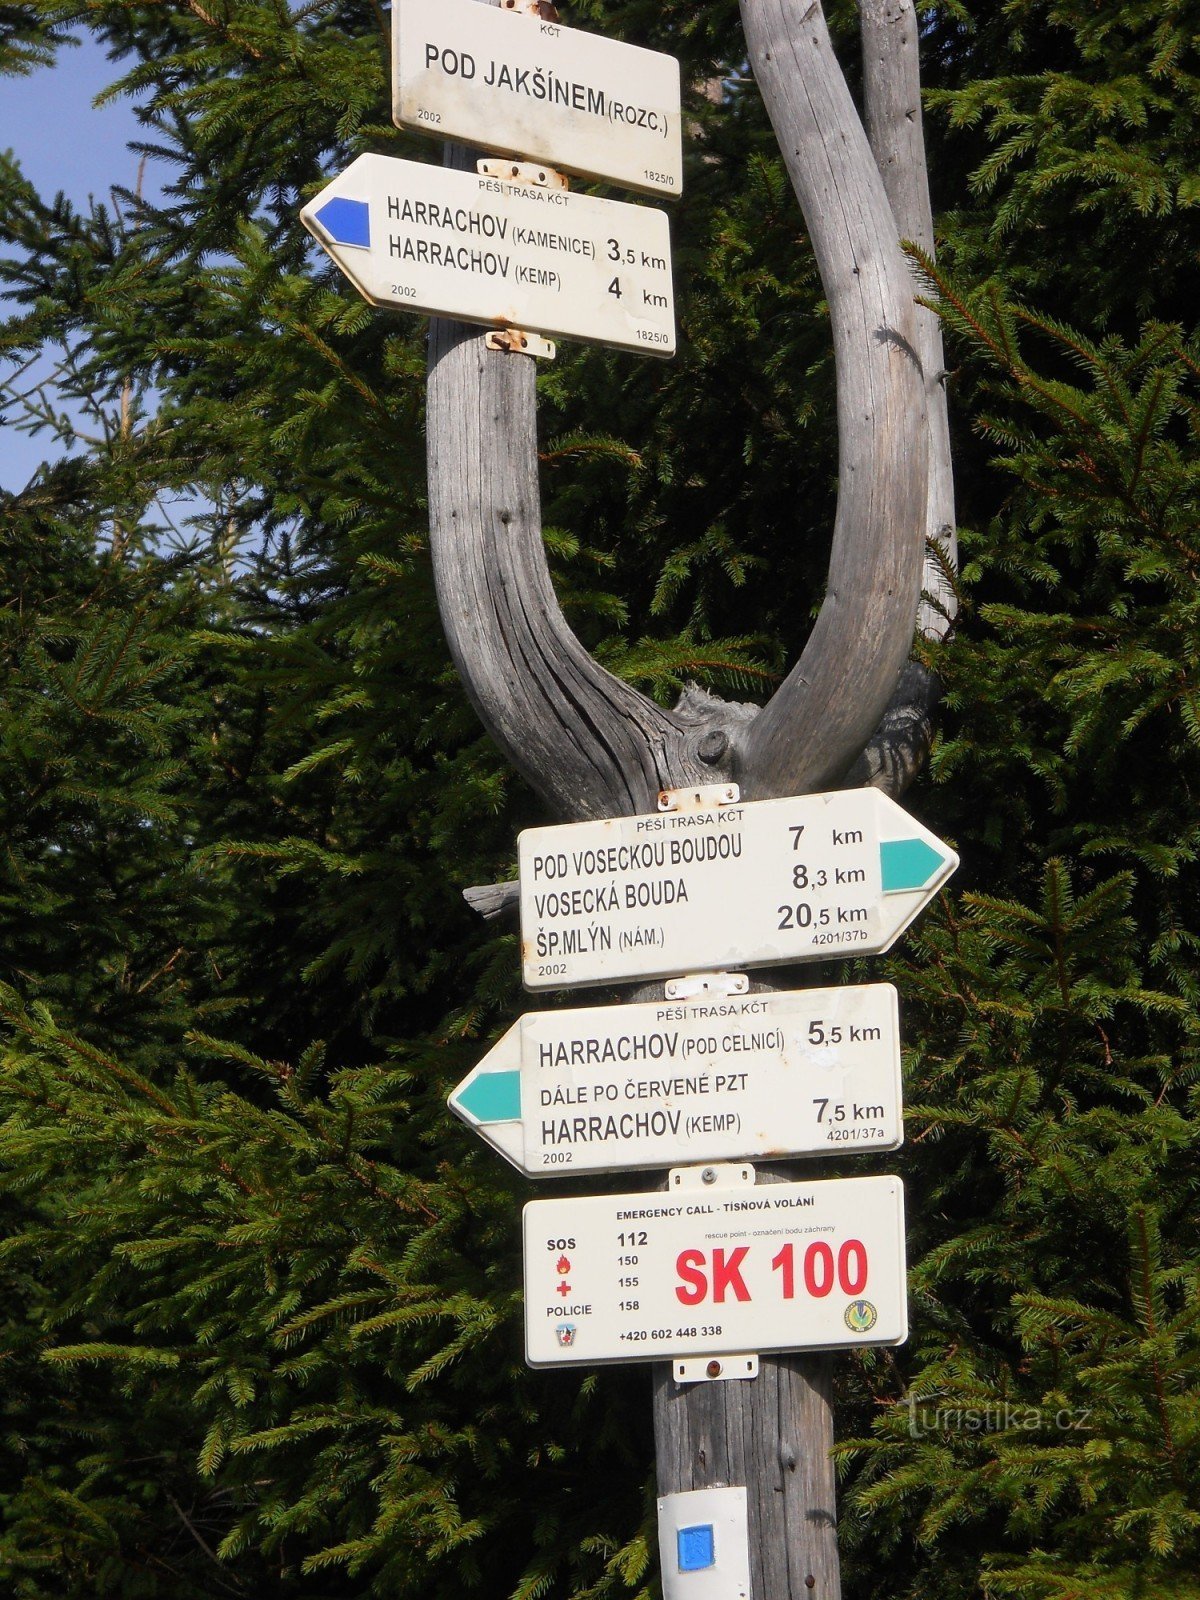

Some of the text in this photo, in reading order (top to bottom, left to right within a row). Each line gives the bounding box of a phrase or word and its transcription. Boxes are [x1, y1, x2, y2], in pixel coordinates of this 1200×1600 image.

[540, 24, 560, 38] KČT
[426, 44, 475, 79] POD
[418, 109, 441, 124] 2002
[644, 169, 674, 186] 1825/0
[478, 180, 569, 206] PĚŠÍ TRASA KČT
[388, 196, 666, 270] HARRACHOV (KAMENICE) 3,5 km
[389, 234, 668, 308] HARRACHOV (KEMP) 4 km
[391, 285, 417, 298] 2002
[636, 330, 668, 344] 1825/0
[637, 809, 744, 832] PĚŠÍ TRASA KČT
[534, 826, 863, 880] POD VOSECKOU BOUDOU 7 km
[535, 865, 865, 918] VOSECKÁ BOUDA 8,3 km
[537, 903, 868, 957] ŠP.MLÝN (NÁM.) 20,5 km
[812, 930, 868, 945] 4201/37b
[538, 963, 567, 976] 2002
[656, 1001, 768, 1021] PĚŠÍ TRASA KČT
[540, 1021, 881, 1067] HARRACHOV (POD CELNICÍ) 5,5 km
[541, 1073, 749, 1106] DÁLE PO ČERVENÉ PZT
[542, 1099, 884, 1145] HARRACHOV (KEMP) 7,5 km
[827, 1127, 884, 1142] 4201/37a
[543, 1152, 572, 1164] 2002
[616, 1207, 683, 1220] EMERGENCY
[687, 1204, 713, 1215] CALL
[723, 1199, 771, 1212] TÍSŇOVÁ
[774, 1196, 814, 1209] VOLÁNÍ
[547, 1231, 648, 1251] SOS 112
[730, 1230, 746, 1239] point
[752, 1227, 783, 1237] označení
[785, 1226, 802, 1235] bodu
[804, 1225, 835, 1235] záchrany
[618, 1255, 638, 1266] 150
[676, 1239, 868, 1305] SK 100
[618, 1277, 639, 1288] 155
[546, 1304, 592, 1317] POLICIE
[619, 1300, 640, 1311] 158
[619, 1326, 722, 1342] +420 602 448 338
